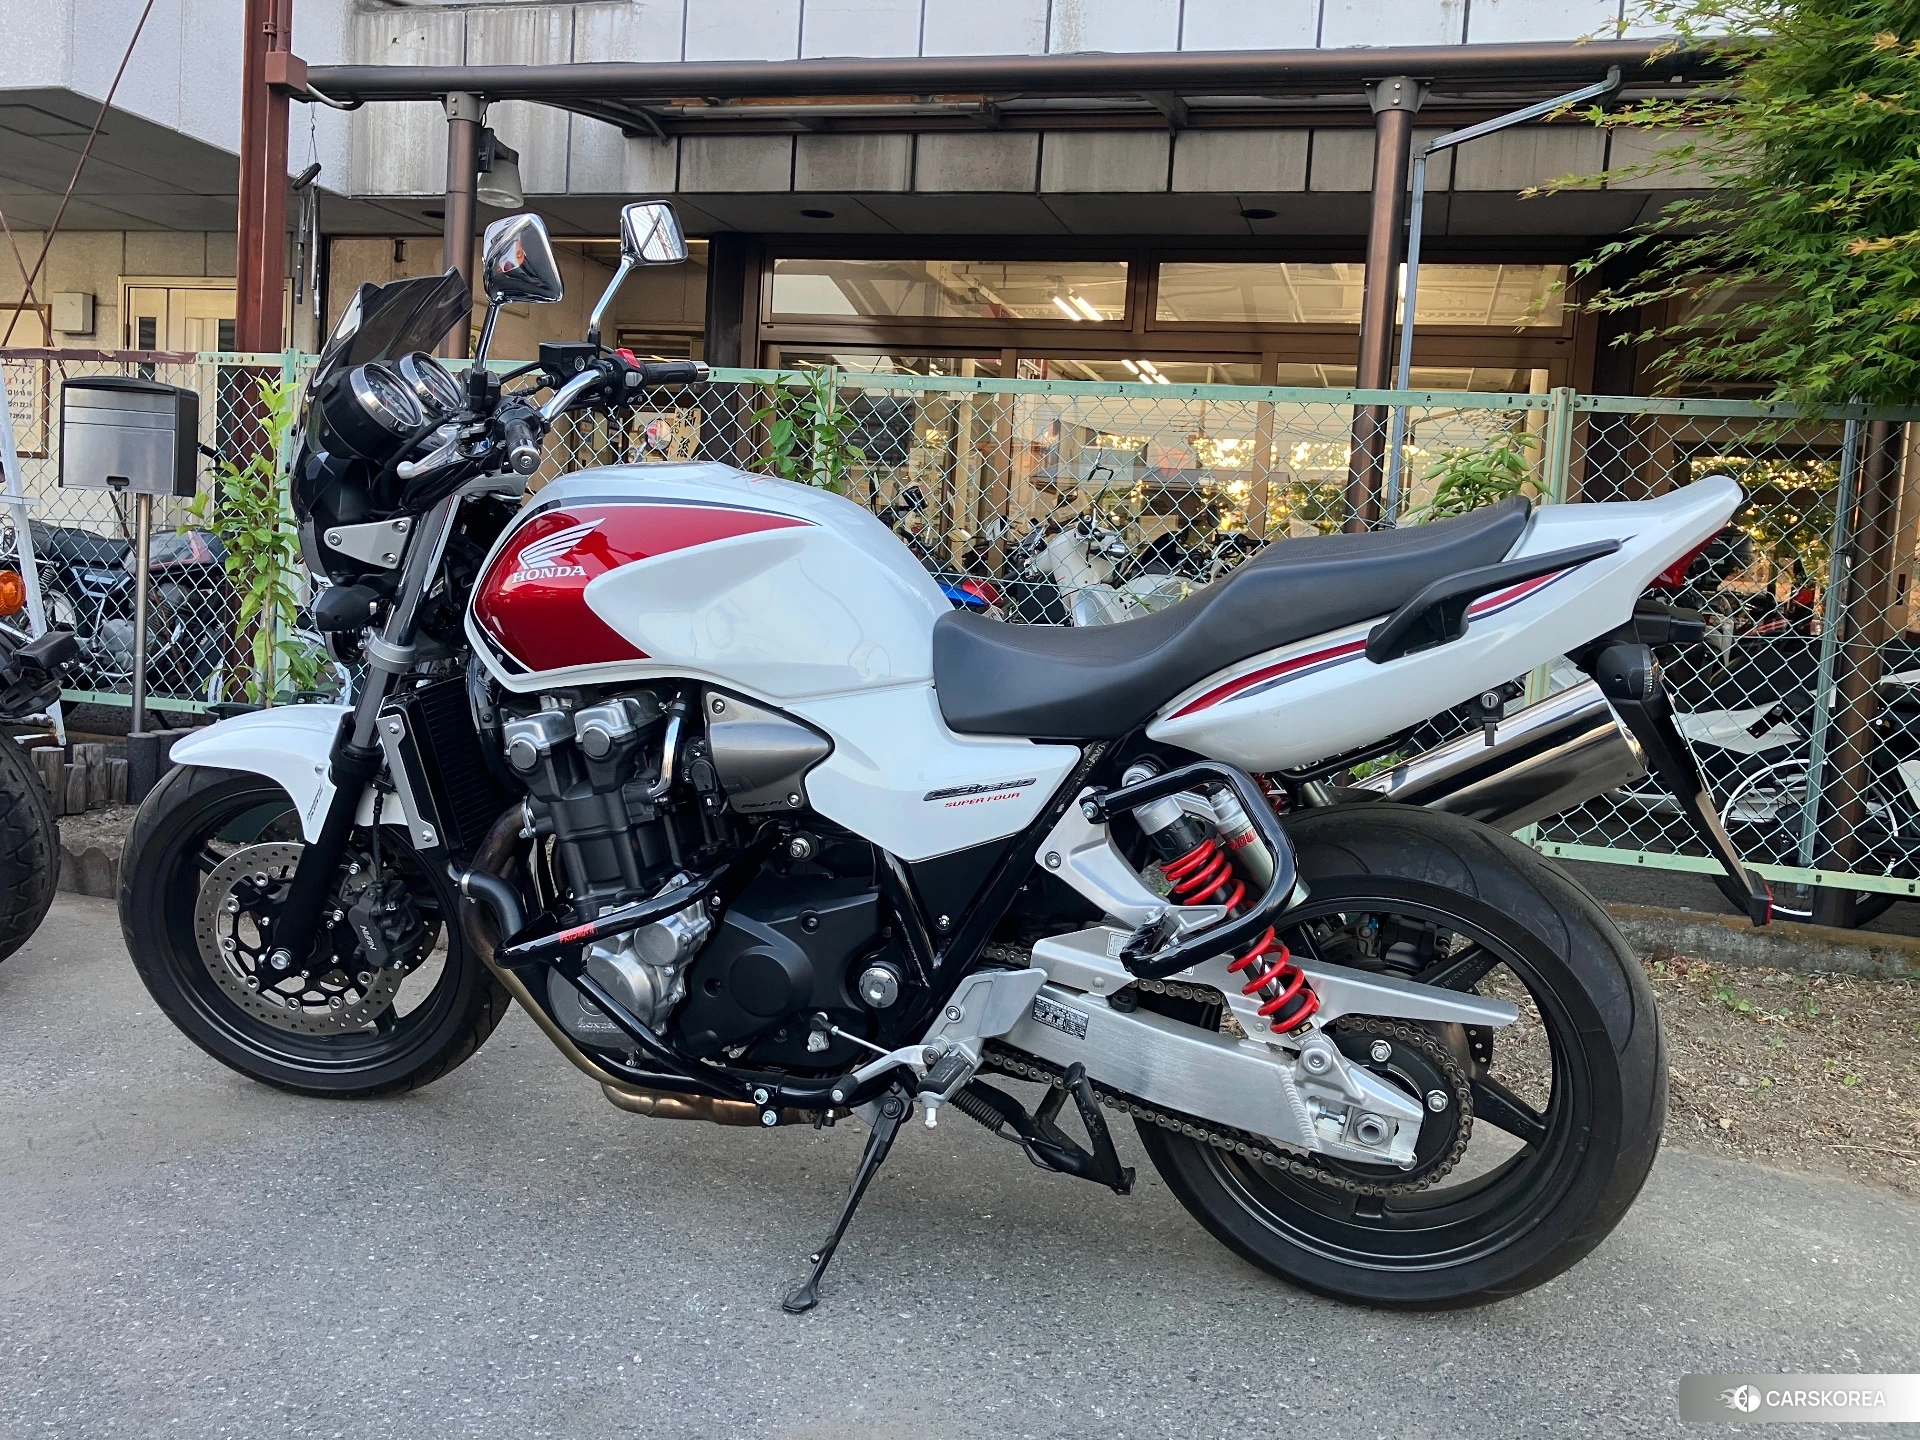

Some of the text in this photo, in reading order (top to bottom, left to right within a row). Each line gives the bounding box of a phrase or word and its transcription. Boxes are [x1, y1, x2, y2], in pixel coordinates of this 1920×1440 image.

[511, 565, 587, 584] HONDA
[944, 792, 1021, 808] SUPER FOUR
